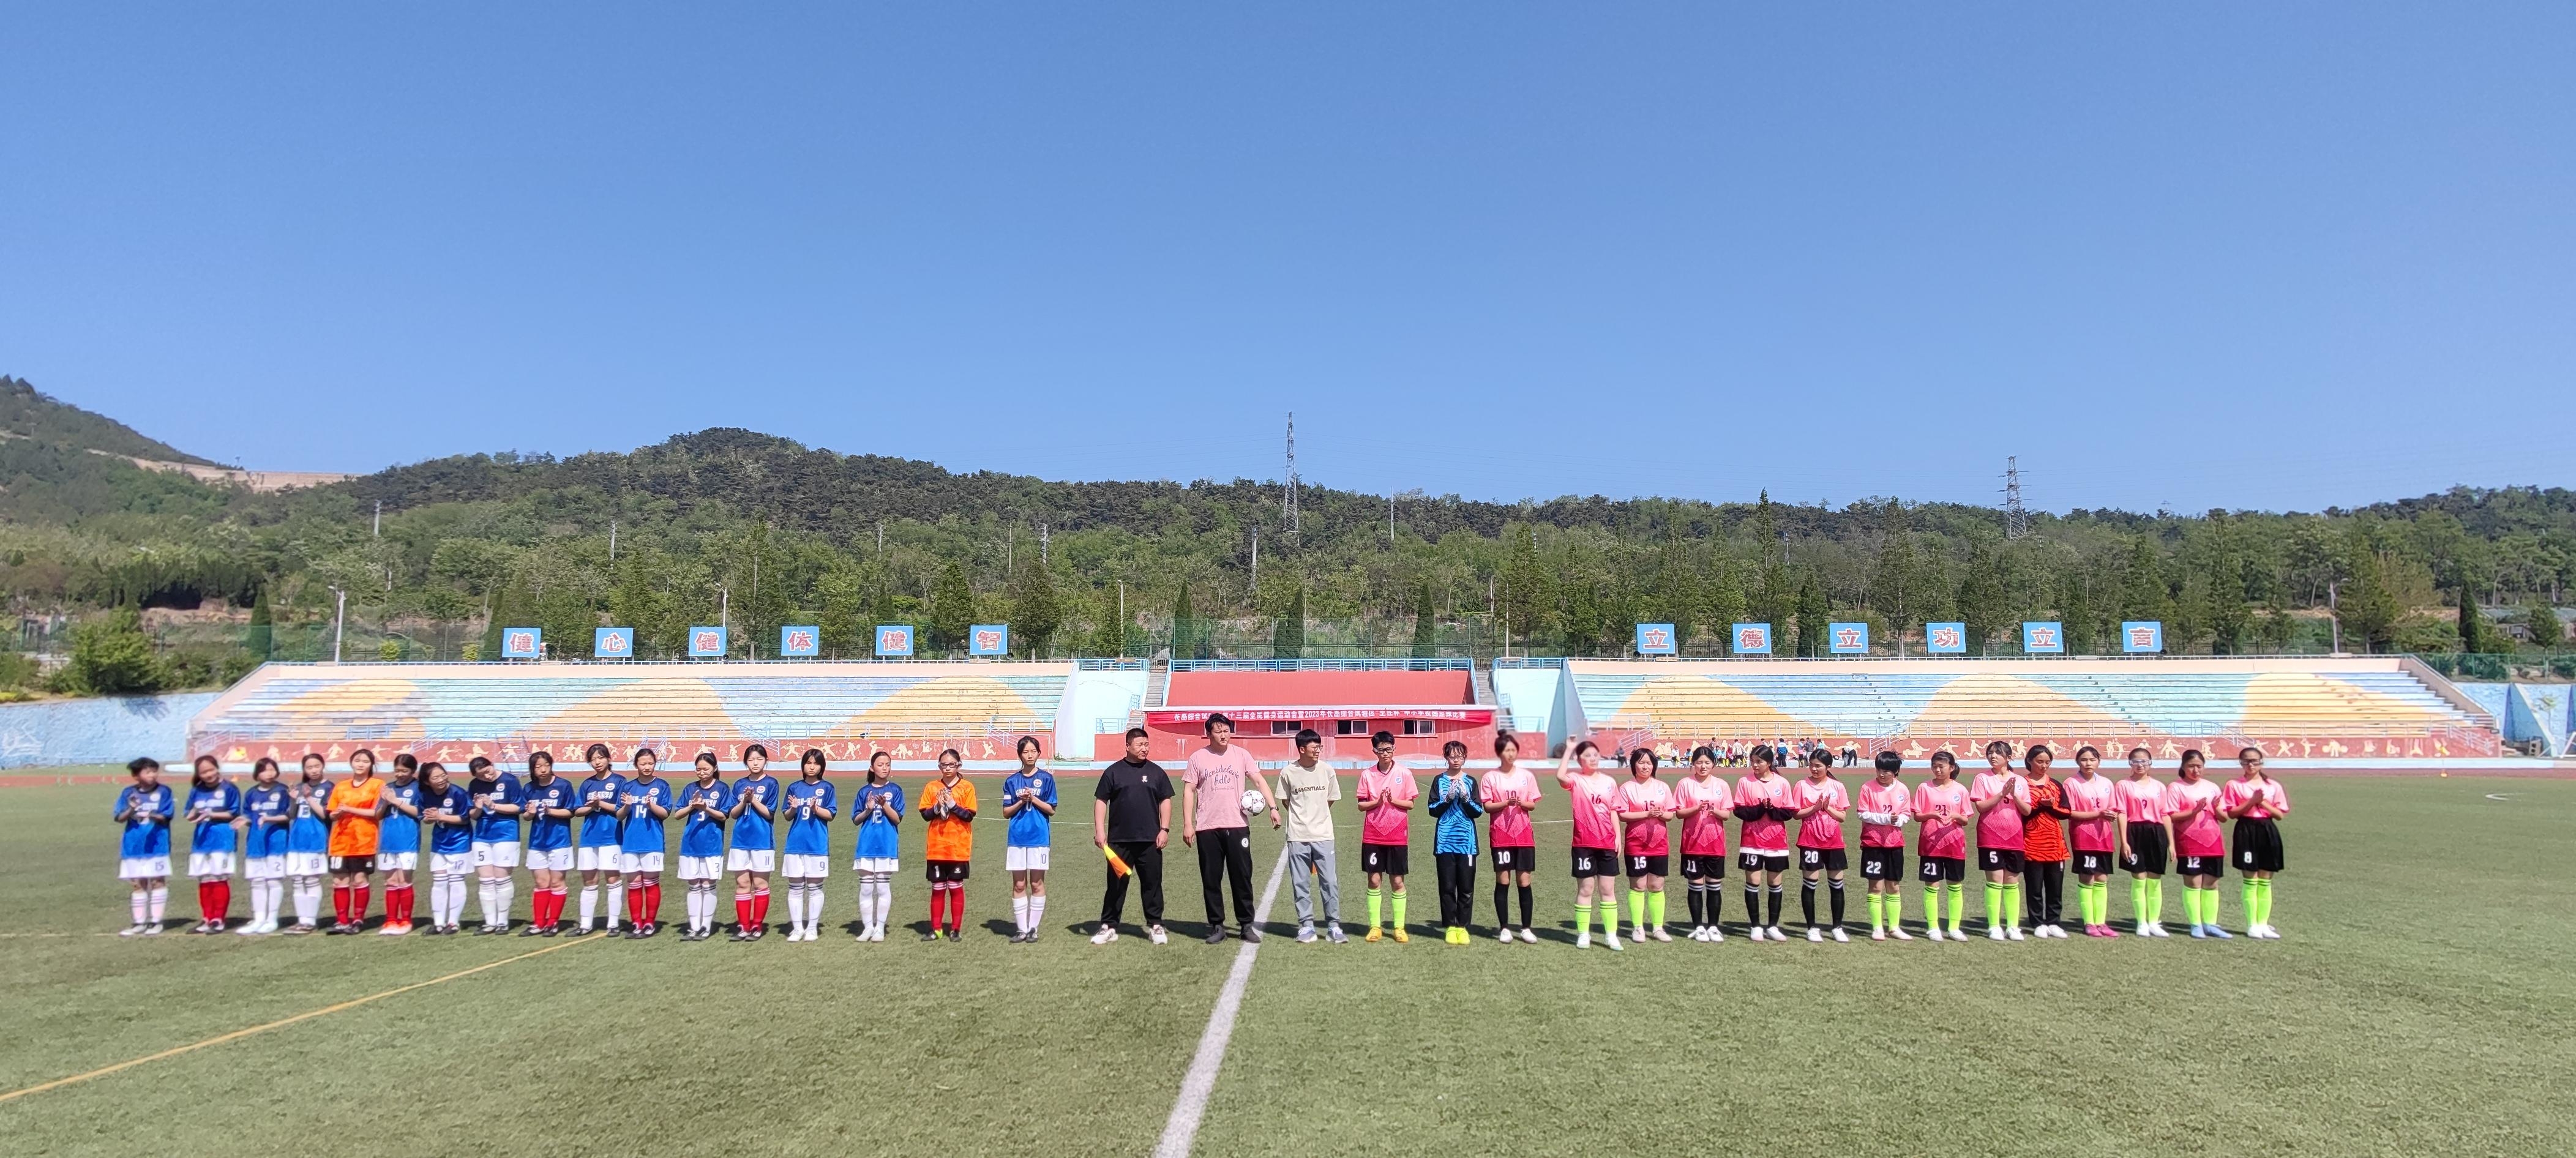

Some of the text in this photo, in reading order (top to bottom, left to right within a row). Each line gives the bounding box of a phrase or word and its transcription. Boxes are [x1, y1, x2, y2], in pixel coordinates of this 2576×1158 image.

[509, 630, 1002, 653] 健 心 健 体 健 智
[1642, 627, 2155, 649] 立 德 立 功 立 言
[1591, 793, 1601, 805] 16
[635, 805, 647, 818] 14
[802, 807, 810, 820] 9
[872, 810, 883, 824] 12
[478, 850, 485, 862] 5
[563, 854, 569, 865] 7
[612, 854, 618, 864] 6
[653, 855, 661, 866] 14
[765, 856, 770, 866] 11
[1369, 852, 1377, 865] 6
[1467, 854, 1473, 867] 1
[1498, 851, 1511, 864] 10
[1745, 853, 1758, 866] 19
[1804, 850, 1818, 864] 20
[1990, 851, 1998, 864] 5
[2084, 855, 2097, 869] 18
[2130, 853, 2138, 865] 9
[2187, 856, 2201, 869] 12
[2244, 851, 2252, 864] 8
[155, 861, 165, 871] 15
[274, 861, 281, 872] 2
[311, 858, 320, 869] 13
[714, 862, 720, 873] 3
[819, 861, 825, 872] 9
[1578, 857, 1592, 870] 16
[1634, 856, 1647, 870] 15
[1687, 859, 1697, 873] 11
[1866, 861, 1881, 875] 22
[1923, 862, 1938, 876] 21
[935, 865, 940, 878] 1
